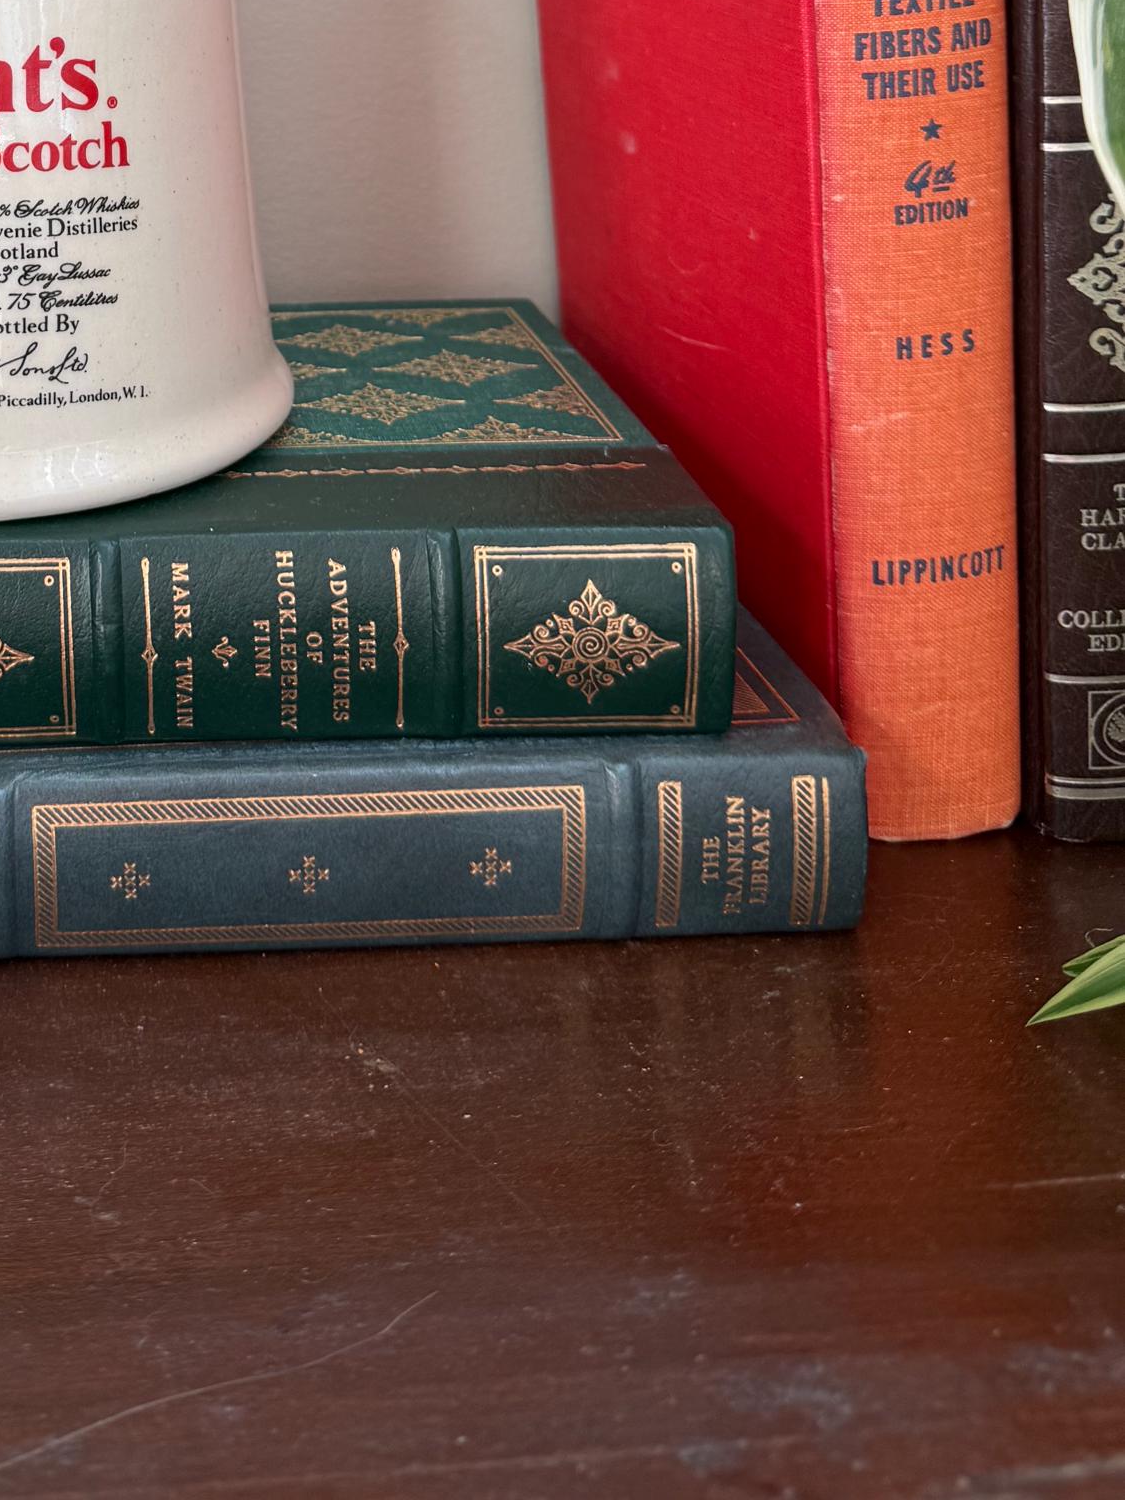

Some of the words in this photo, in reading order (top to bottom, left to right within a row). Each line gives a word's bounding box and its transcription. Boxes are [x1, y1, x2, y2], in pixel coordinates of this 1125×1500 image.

[854, 25, 942, 61] FIBERS
[951, 17, 992, 52] AND
[861, 67, 937, 100] THEIR
[947, 60, 985, 93] USE
[13, 199, 74, 219] Scotch
[74, 196, 141, 216] Whiskies
[46, 217, 138, 238] Distilleries
[893, 197, 969, 226] EDITION
[17, 263, 59, 290] Gay
[57, 261, 112, 281] Lussac
[7, 292, 37, 310] 75
[38, 290, 119, 312] Centilitres
[55, 313, 81, 335] By
[896, 329, 975, 360] HESS
[69, 388, 123, 405] London,
[870, 545, 1006, 586] LIPPINCOTT
[171, 561, 193, 640] MARK
[252, 619, 272, 678] FINN
[275, 550, 299, 732] HUCKLEBERRY
[305, 630, 324, 665] OF
[327, 557, 351, 724] ADVENTURES
[358, 620, 377, 672] THE
[175, 656, 194, 729] TWAIN
[701, 835, 722, 885] THE
[723, 795, 746, 916] FRANKLIN
[749, 806, 772, 904] LIBRARY
